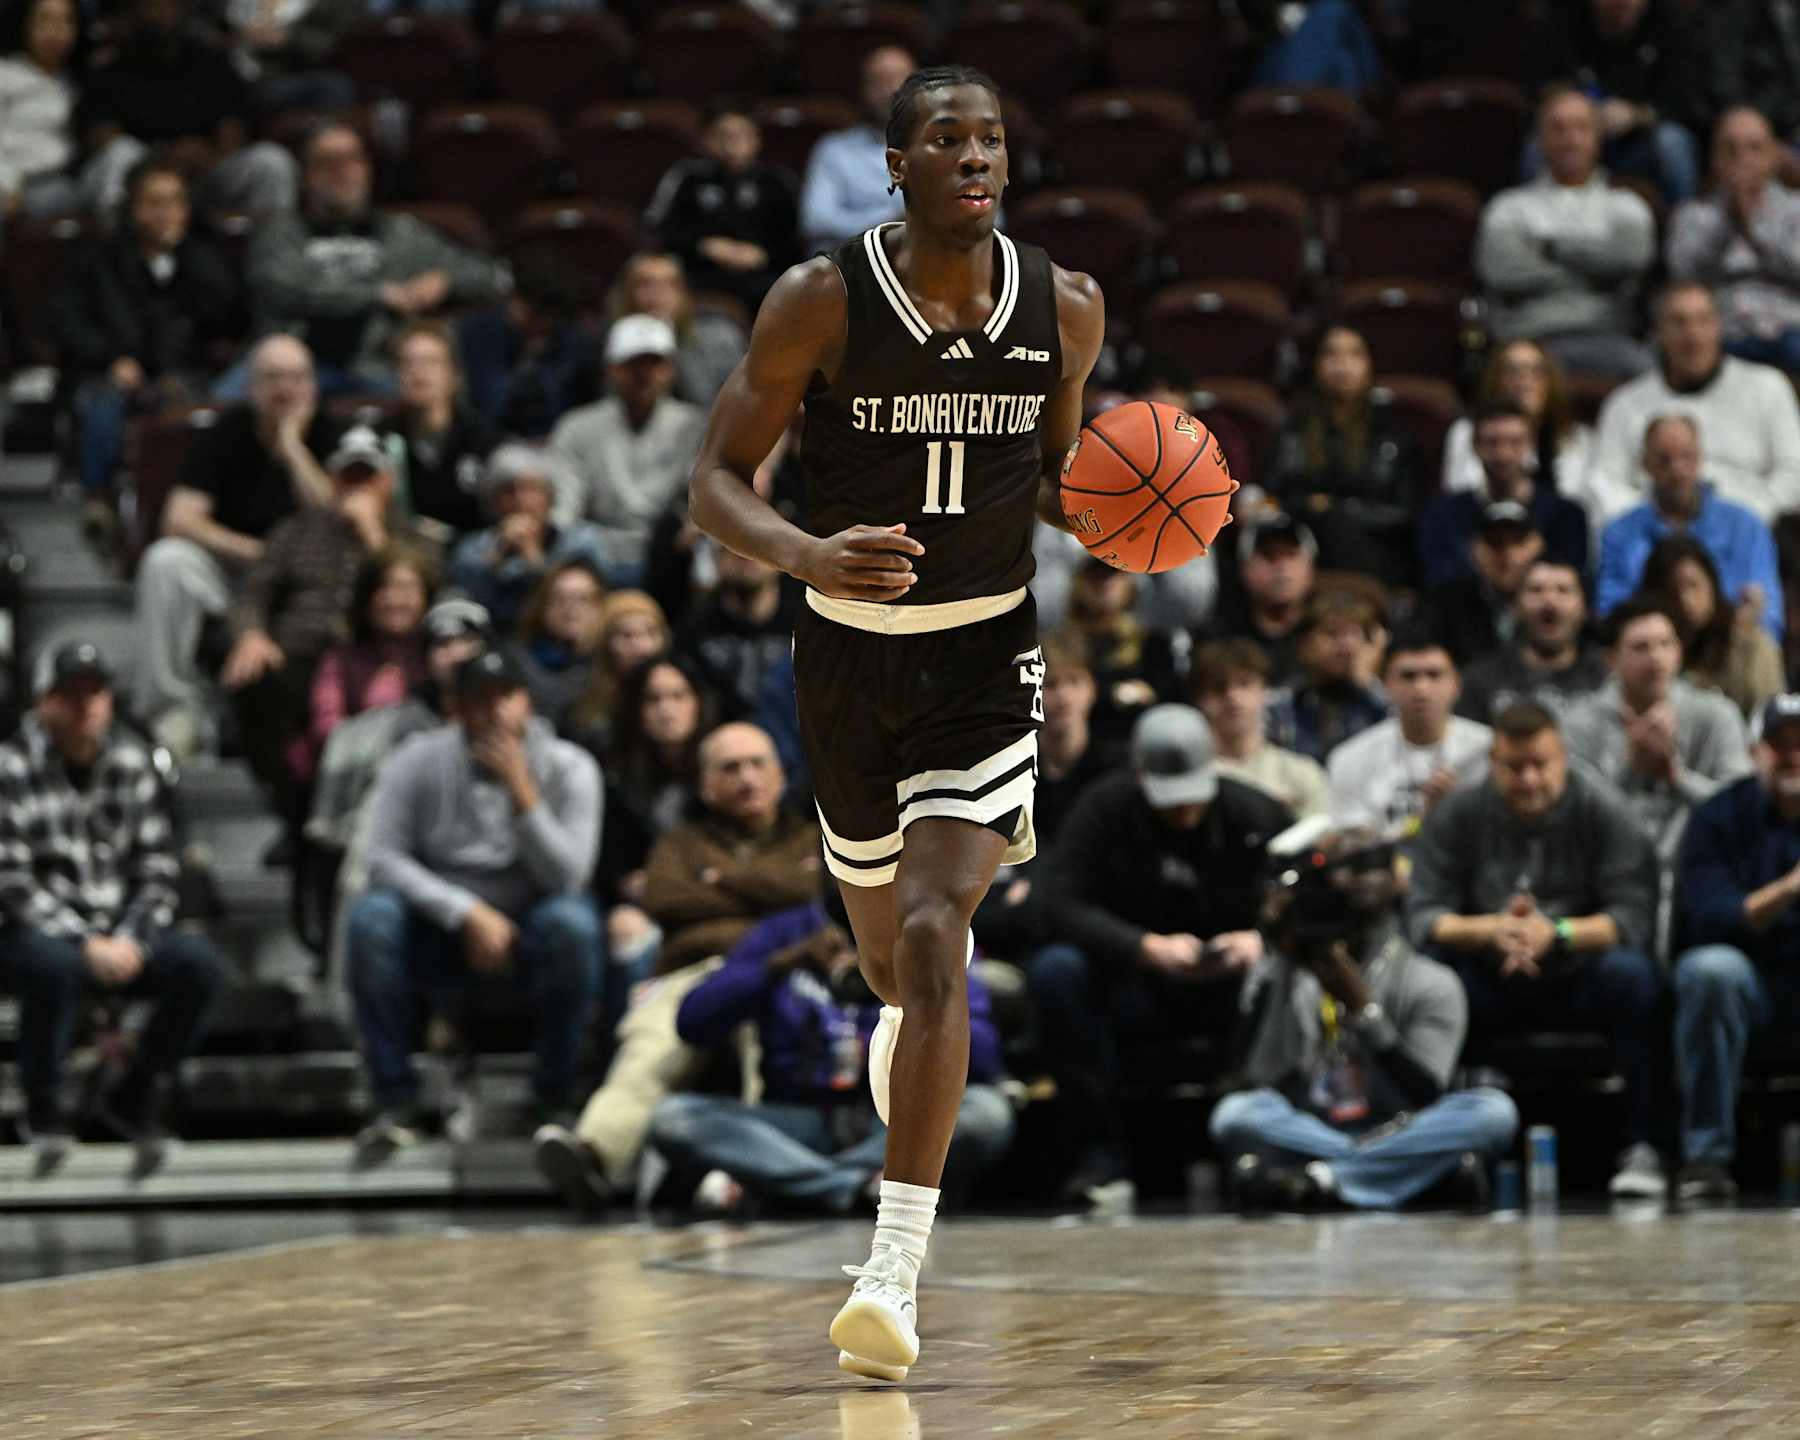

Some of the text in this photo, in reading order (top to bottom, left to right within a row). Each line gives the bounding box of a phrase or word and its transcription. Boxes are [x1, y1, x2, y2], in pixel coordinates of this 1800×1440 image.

[1003, 345, 1050, 362] A10
[852, 393, 1046, 435] ST. BONAVENTURE
[922, 441, 966, 514] 11
